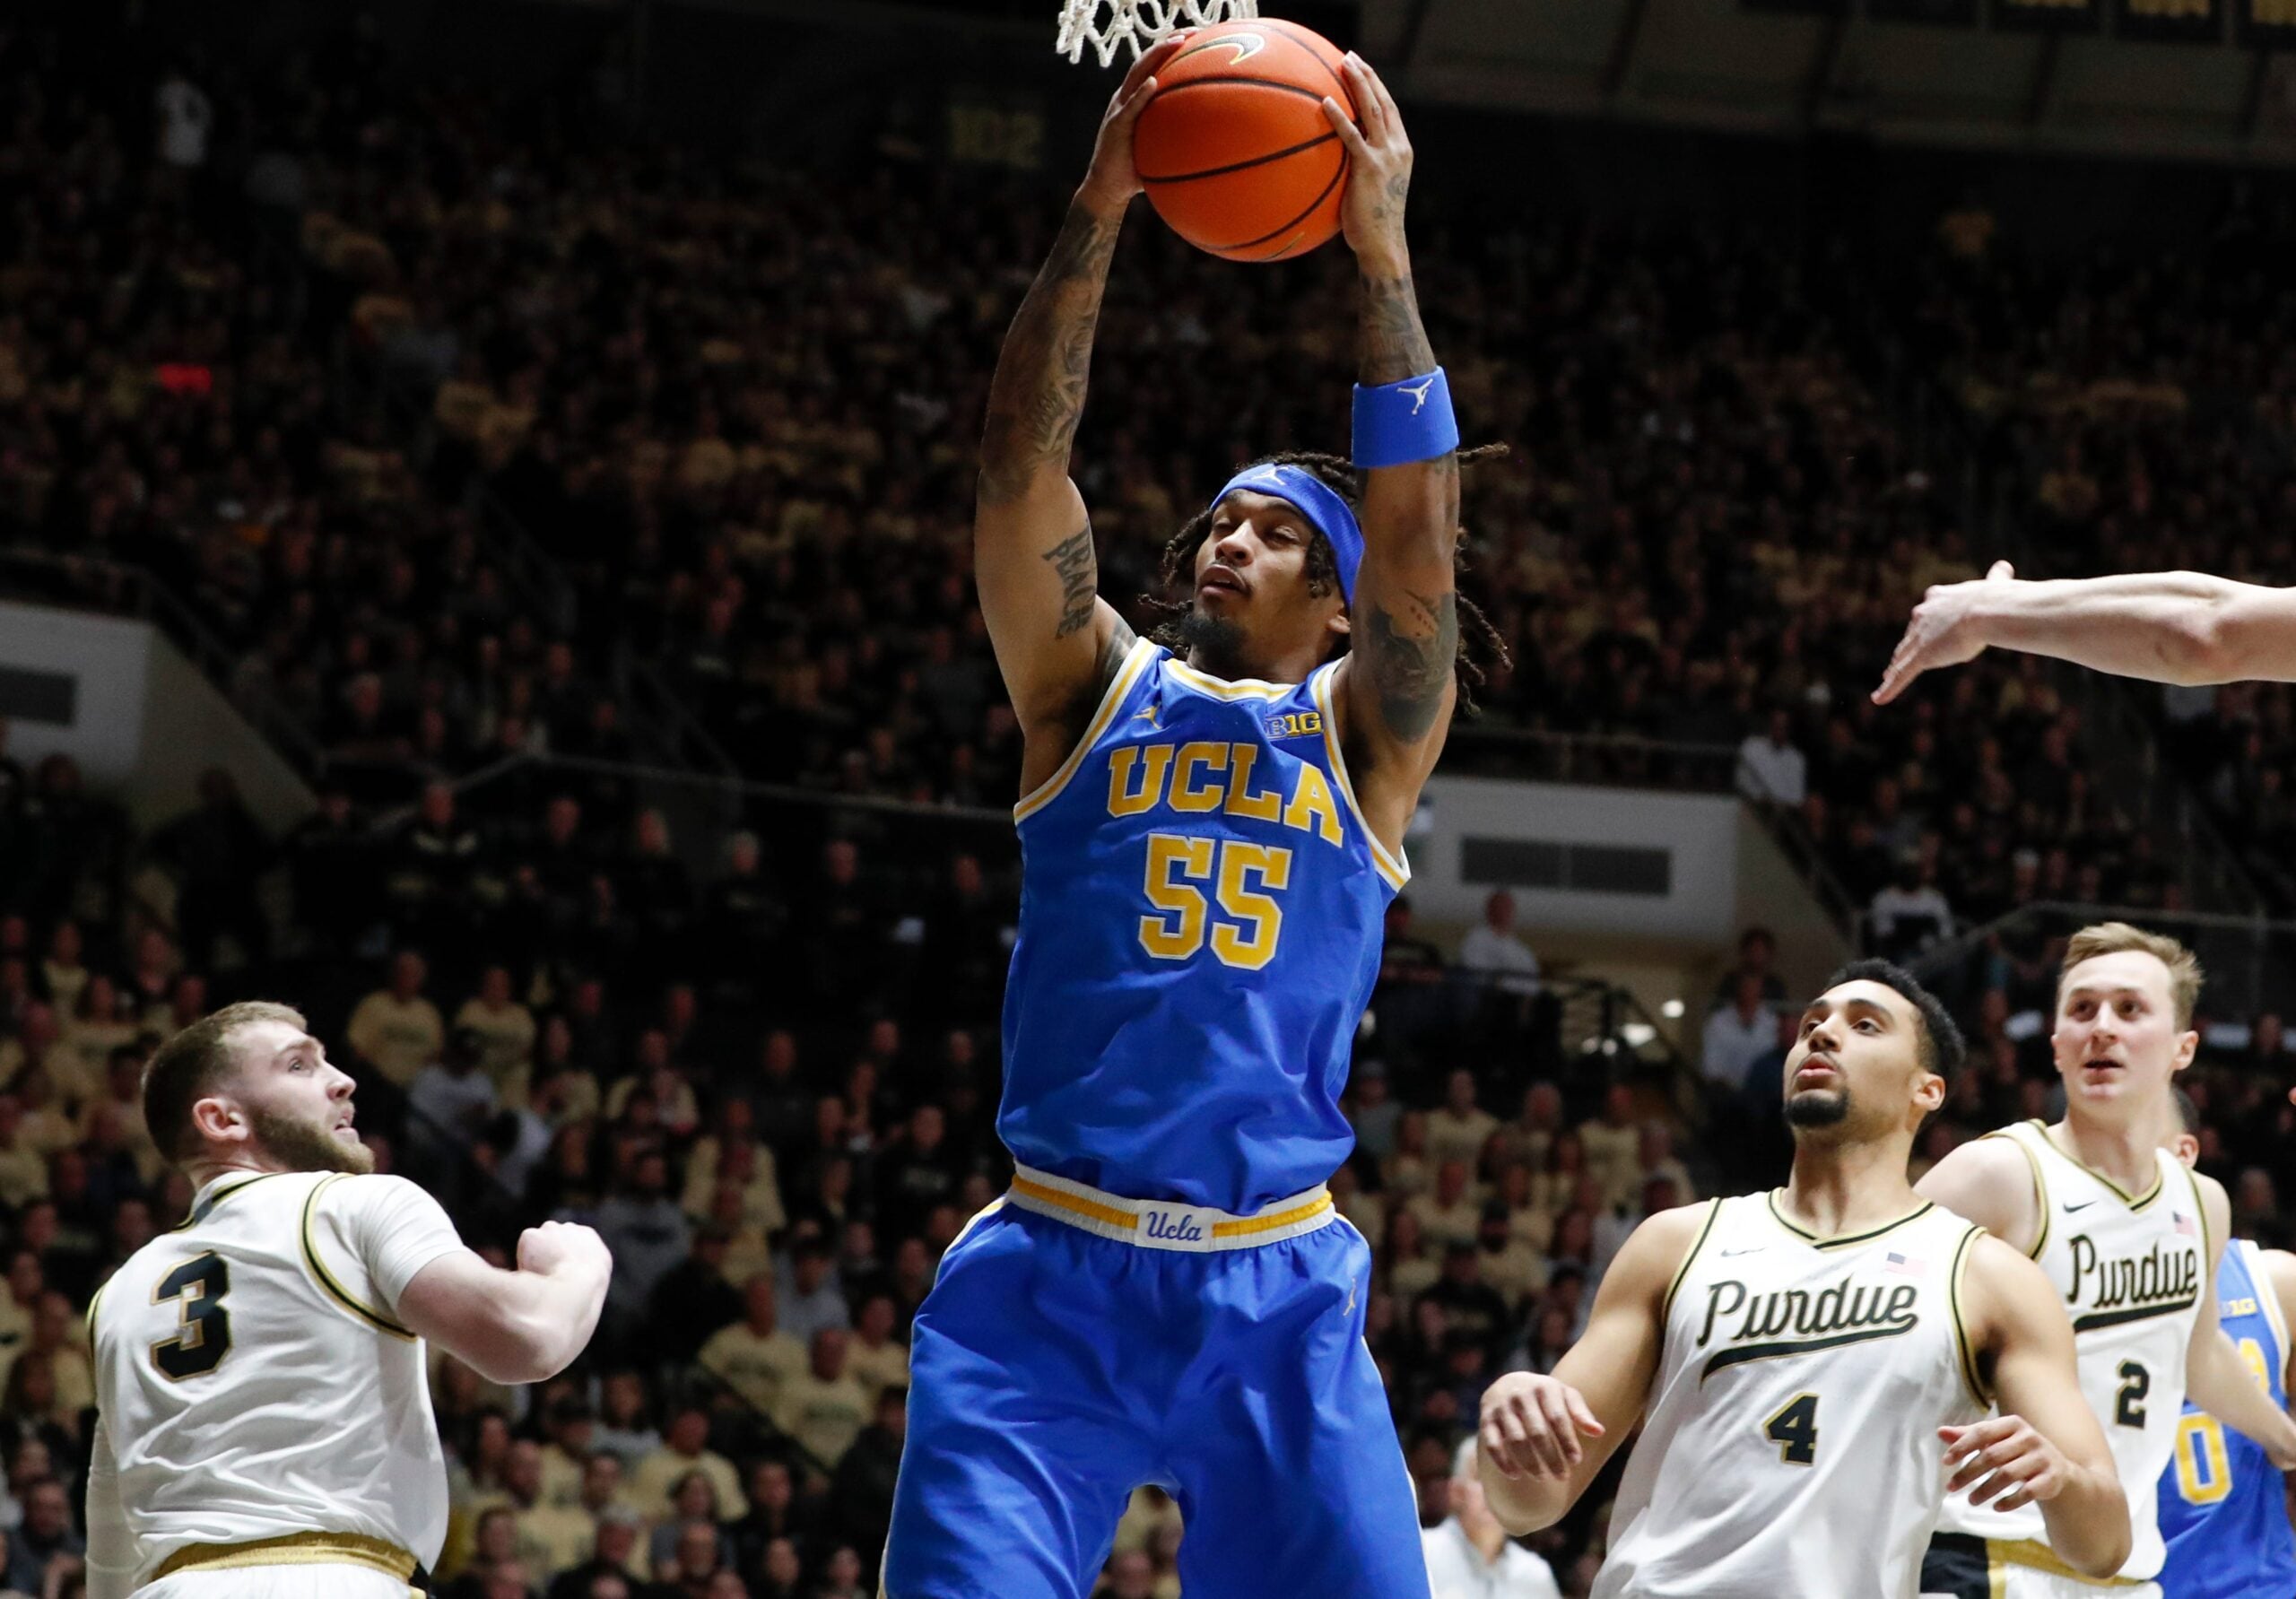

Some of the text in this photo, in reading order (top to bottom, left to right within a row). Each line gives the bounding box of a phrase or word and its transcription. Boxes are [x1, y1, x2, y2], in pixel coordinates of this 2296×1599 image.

[1265, 710, 1323, 739] B1G
[1107, 742, 1344, 848] UCLA
[1139, 833, 1292, 971] 55
[1146, 1211, 1203, 1243] Ucla
[2066, 1233, 2198, 1308] Purdue
[149, 1248, 233, 1384] 3
[1696, 1271, 1920, 1348] Purdue
[1761, 1391, 1821, 1467] 4
[2114, 1358, 2151, 1430] 2
[2174, 1412, 2233, 1506] 0
